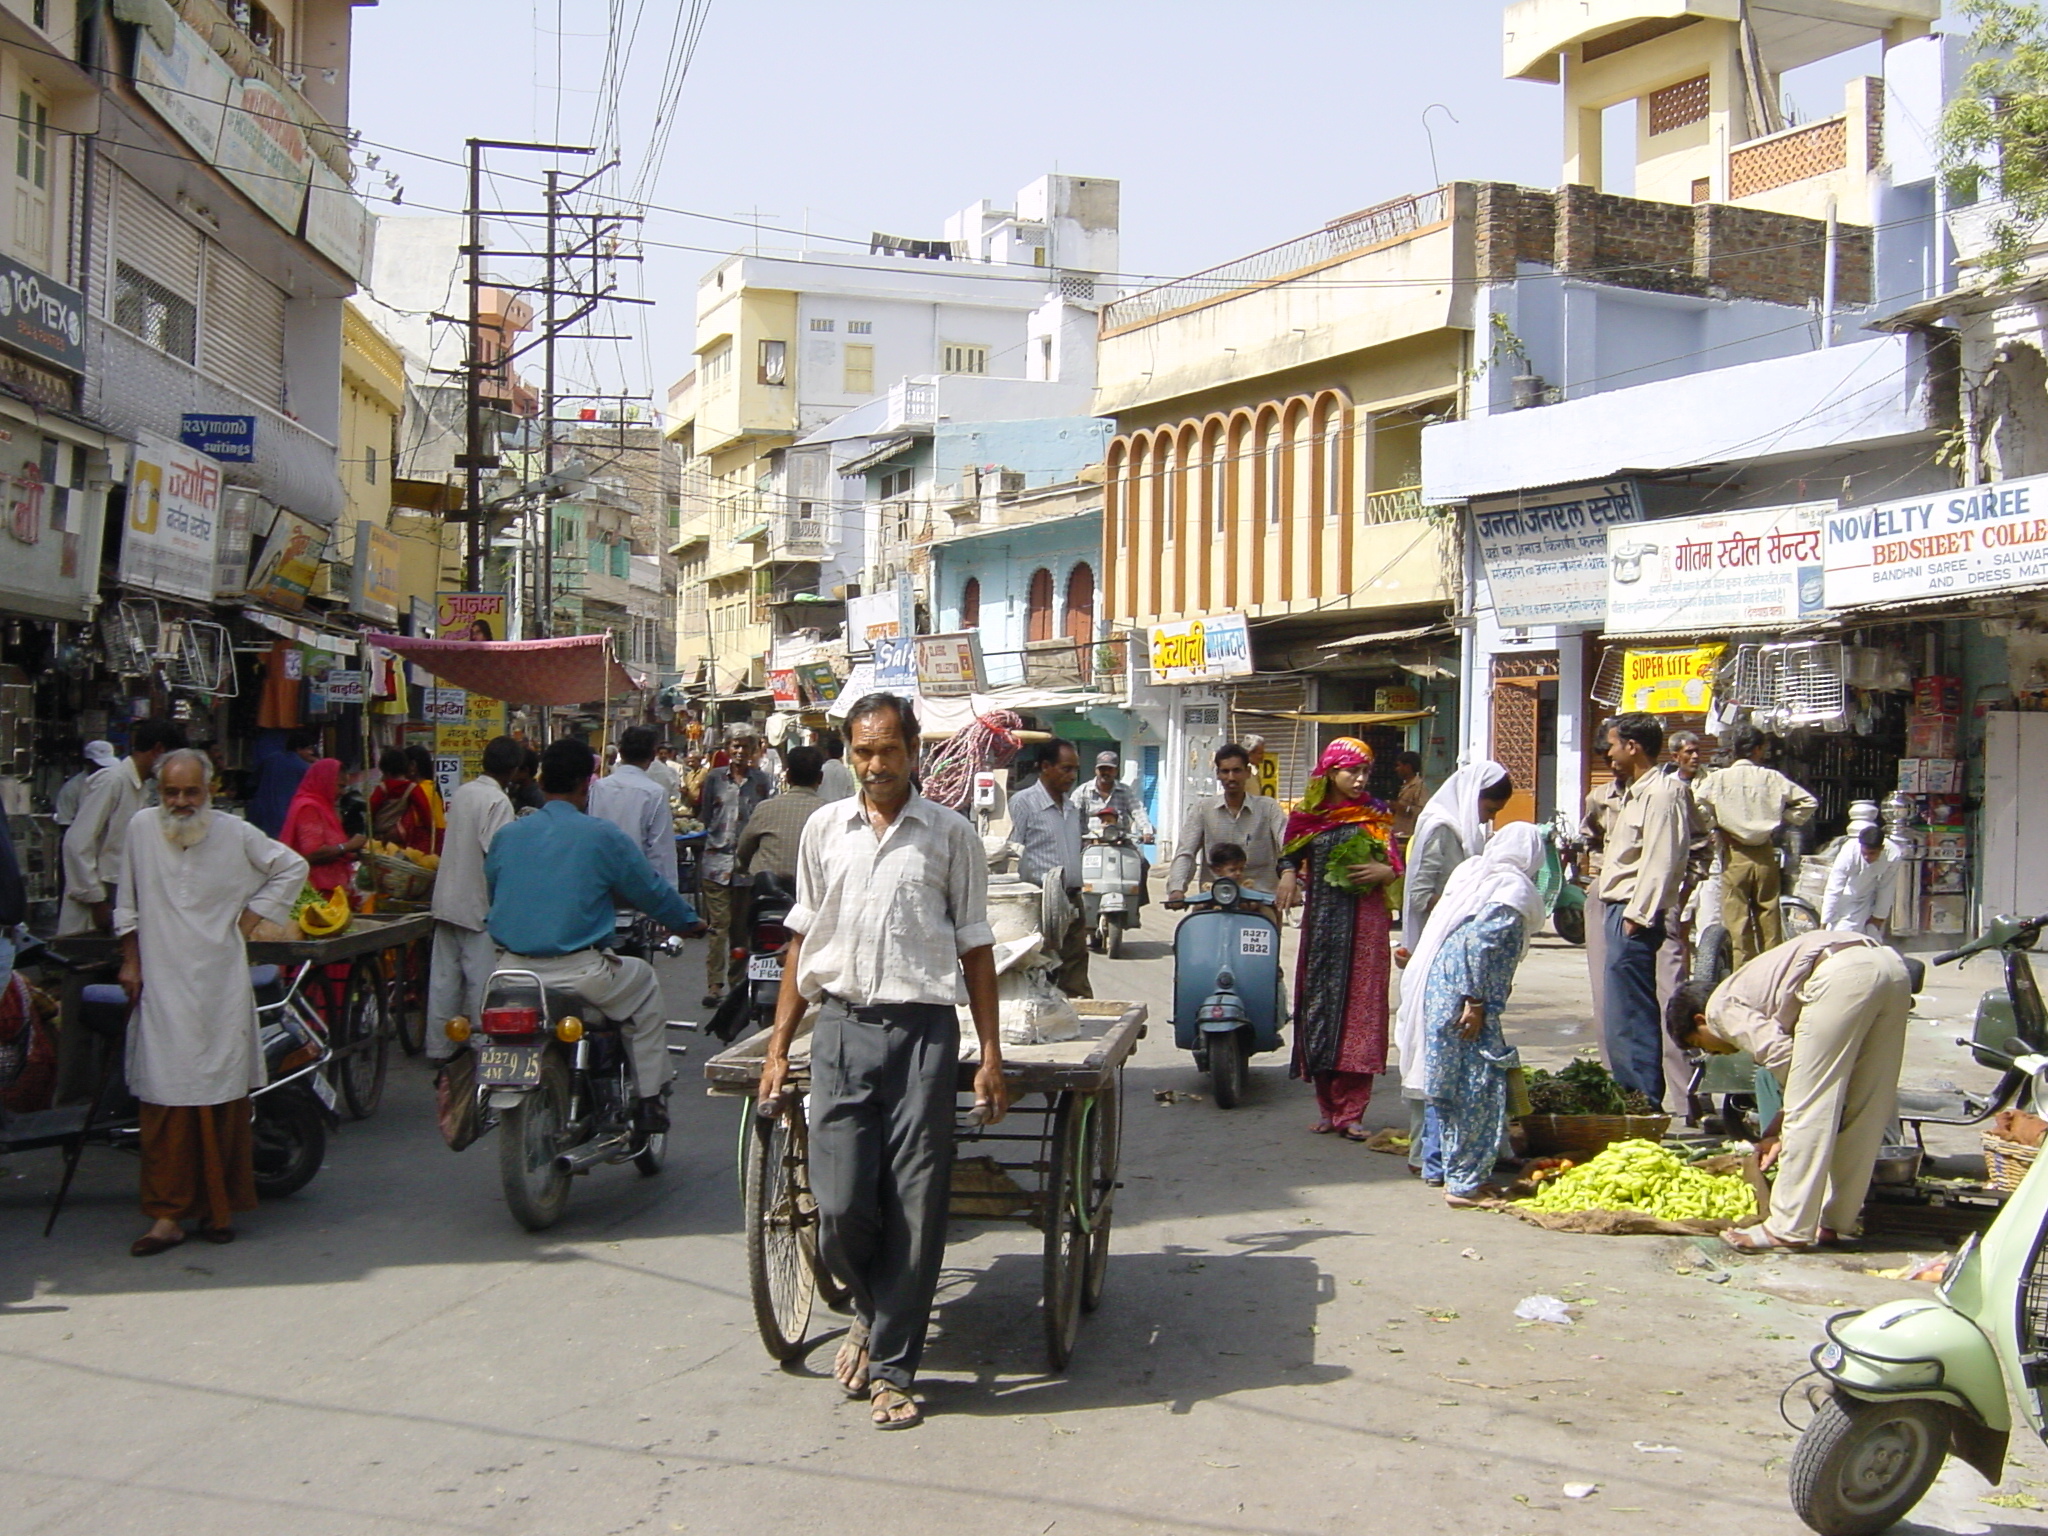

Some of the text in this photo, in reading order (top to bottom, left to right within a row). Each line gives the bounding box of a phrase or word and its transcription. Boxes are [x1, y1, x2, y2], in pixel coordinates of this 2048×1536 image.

[182, 419, 247, 437] Raymond
[203, 443, 250, 457] suitings
[169, 458, 219, 512] ज्योति
[1829, 503, 1935, 545] NOVELTY
[1946, 487, 2030, 524] SAREE
[1717, 531, 1761, 569] स्टील
[1766, 526, 1821, 565] सेन्टर
[1872, 529, 1975, 566] BEDSHEET
[1873, 566, 1922, 583] BANDHNI
[1928, 559, 1968, 576] SAREE
[1929, 575, 1955, 589] AND
[1968, 568, 2012, 585] DRESS
[1632, 654, 1693, 680] SUPER LITE
[481, 1052, 509, 1064] RJ27
